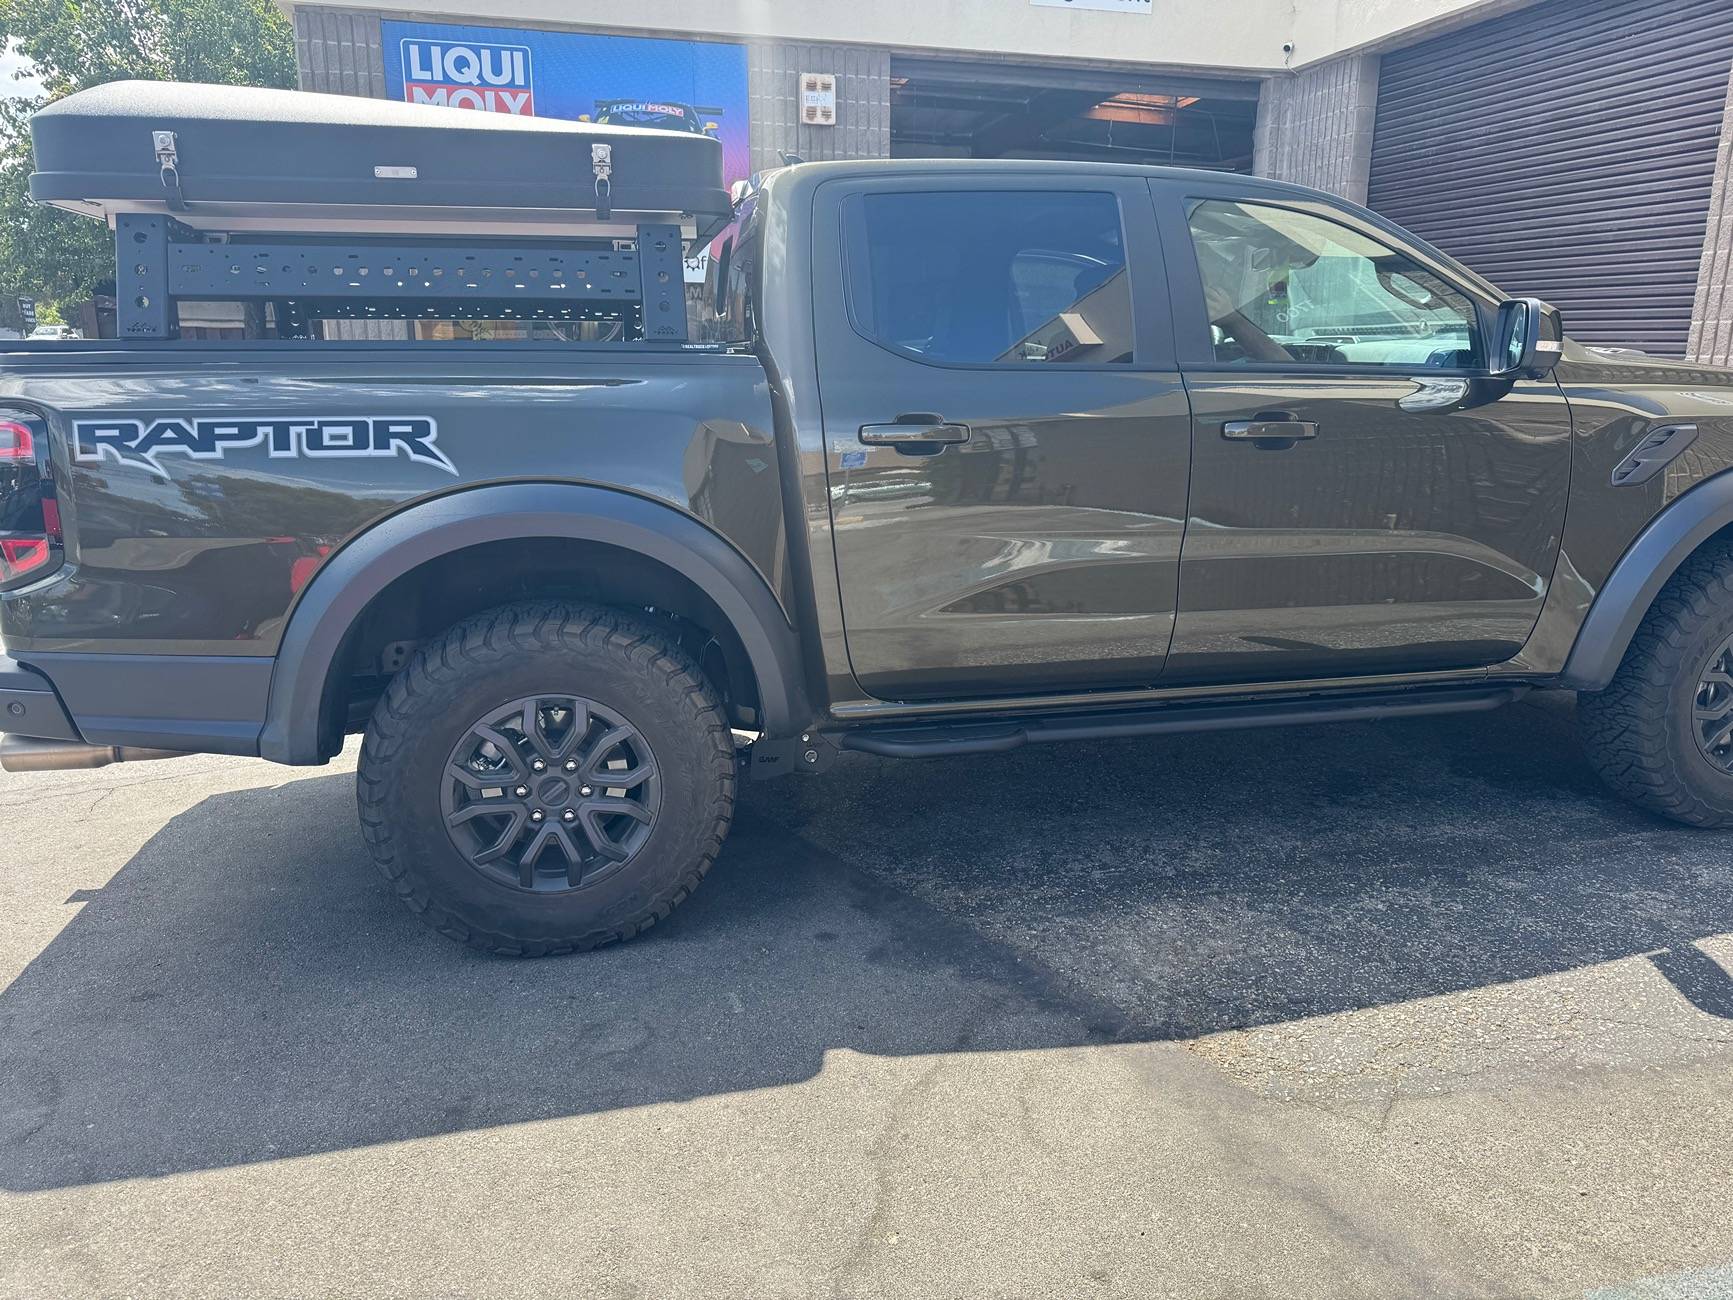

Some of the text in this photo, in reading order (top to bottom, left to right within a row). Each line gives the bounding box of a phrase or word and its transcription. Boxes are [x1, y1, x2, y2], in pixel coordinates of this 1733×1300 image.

[409, 45, 525, 86] LIQUI
[613, 103, 684, 117] LIQUI MOLY
[72, 416, 460, 480] RAPTOR
